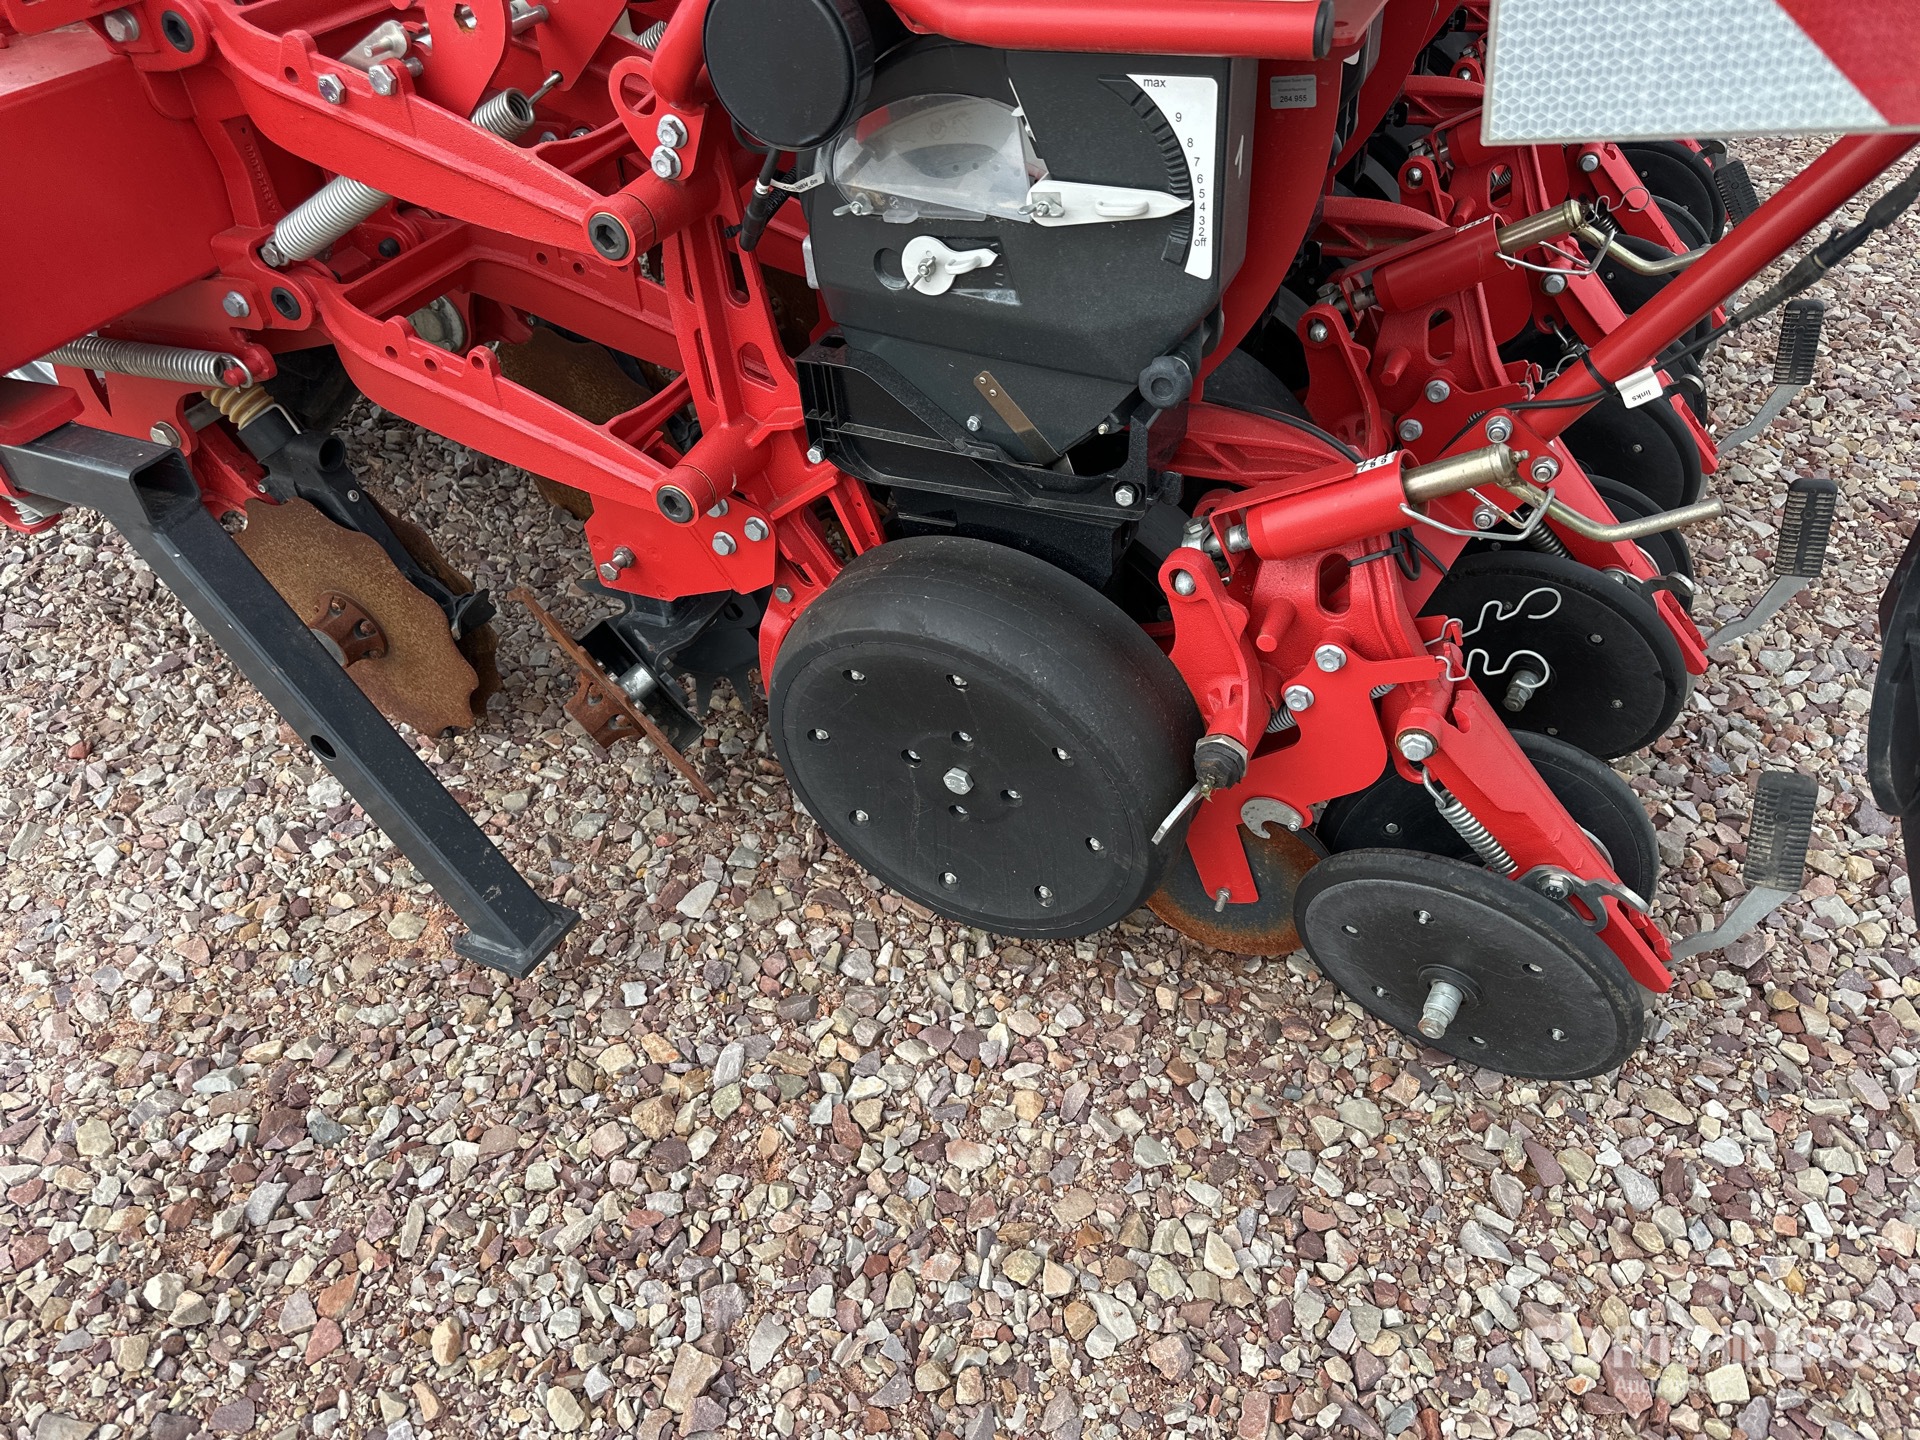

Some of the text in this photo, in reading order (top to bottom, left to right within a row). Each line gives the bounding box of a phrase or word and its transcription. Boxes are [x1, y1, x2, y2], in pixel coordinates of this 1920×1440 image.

[1143, 77, 1166, 88] max
[1175, 112, 1182, 122] 9
[1186, 137, 1194, 148] 8
[1193, 157, 1200, 167] 7
[1196, 174, 1203, 184] 6
[1199, 189, 1205, 199] 5
[1199, 202, 1206, 211] 4
[1199, 215, 1205, 225] 3
[1198, 227, 1205, 237] 2
[1194, 237, 1207, 247] off
[1631, 389, 1652, 402] links
